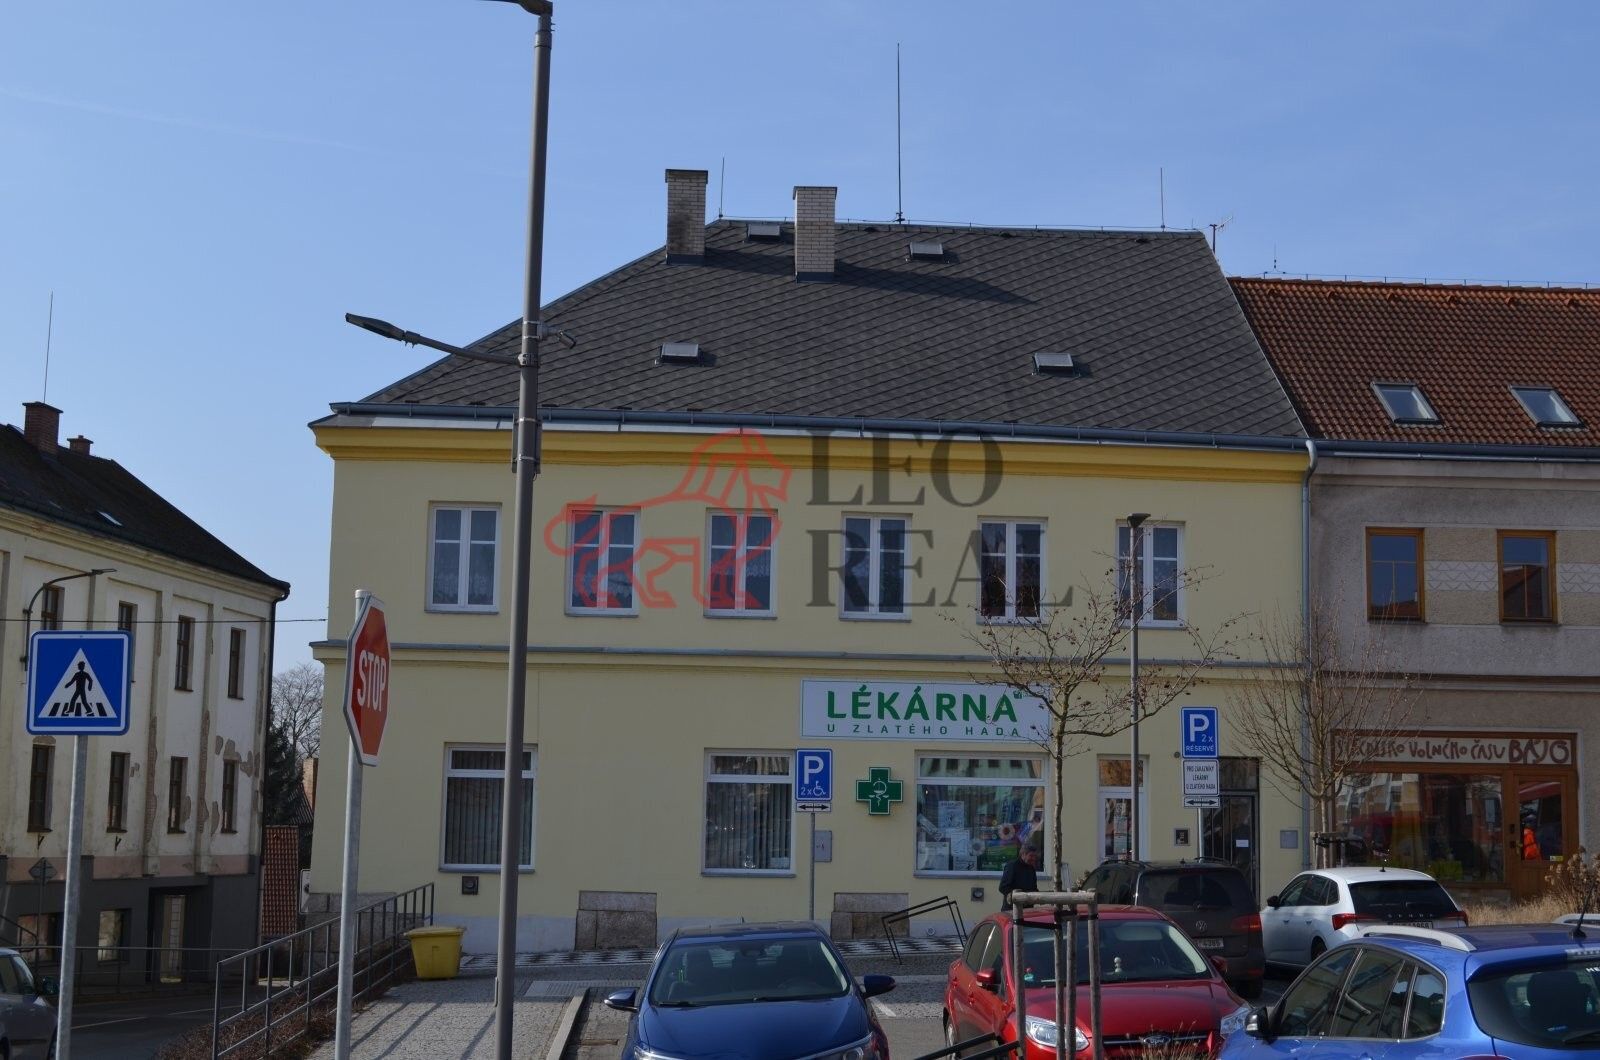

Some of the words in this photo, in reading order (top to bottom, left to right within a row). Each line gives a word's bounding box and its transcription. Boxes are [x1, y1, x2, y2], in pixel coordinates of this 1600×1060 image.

[356, 649, 387, 712] STOP
[826, 684, 1018, 722] LÉKÁRNA
[827, 723, 835, 733] U
[852, 723, 948, 736] ZLATÉHO
[965, 725, 1020, 737] HADA
[1189, 713, 1209, 742] P
[803, 755, 825, 785] P
